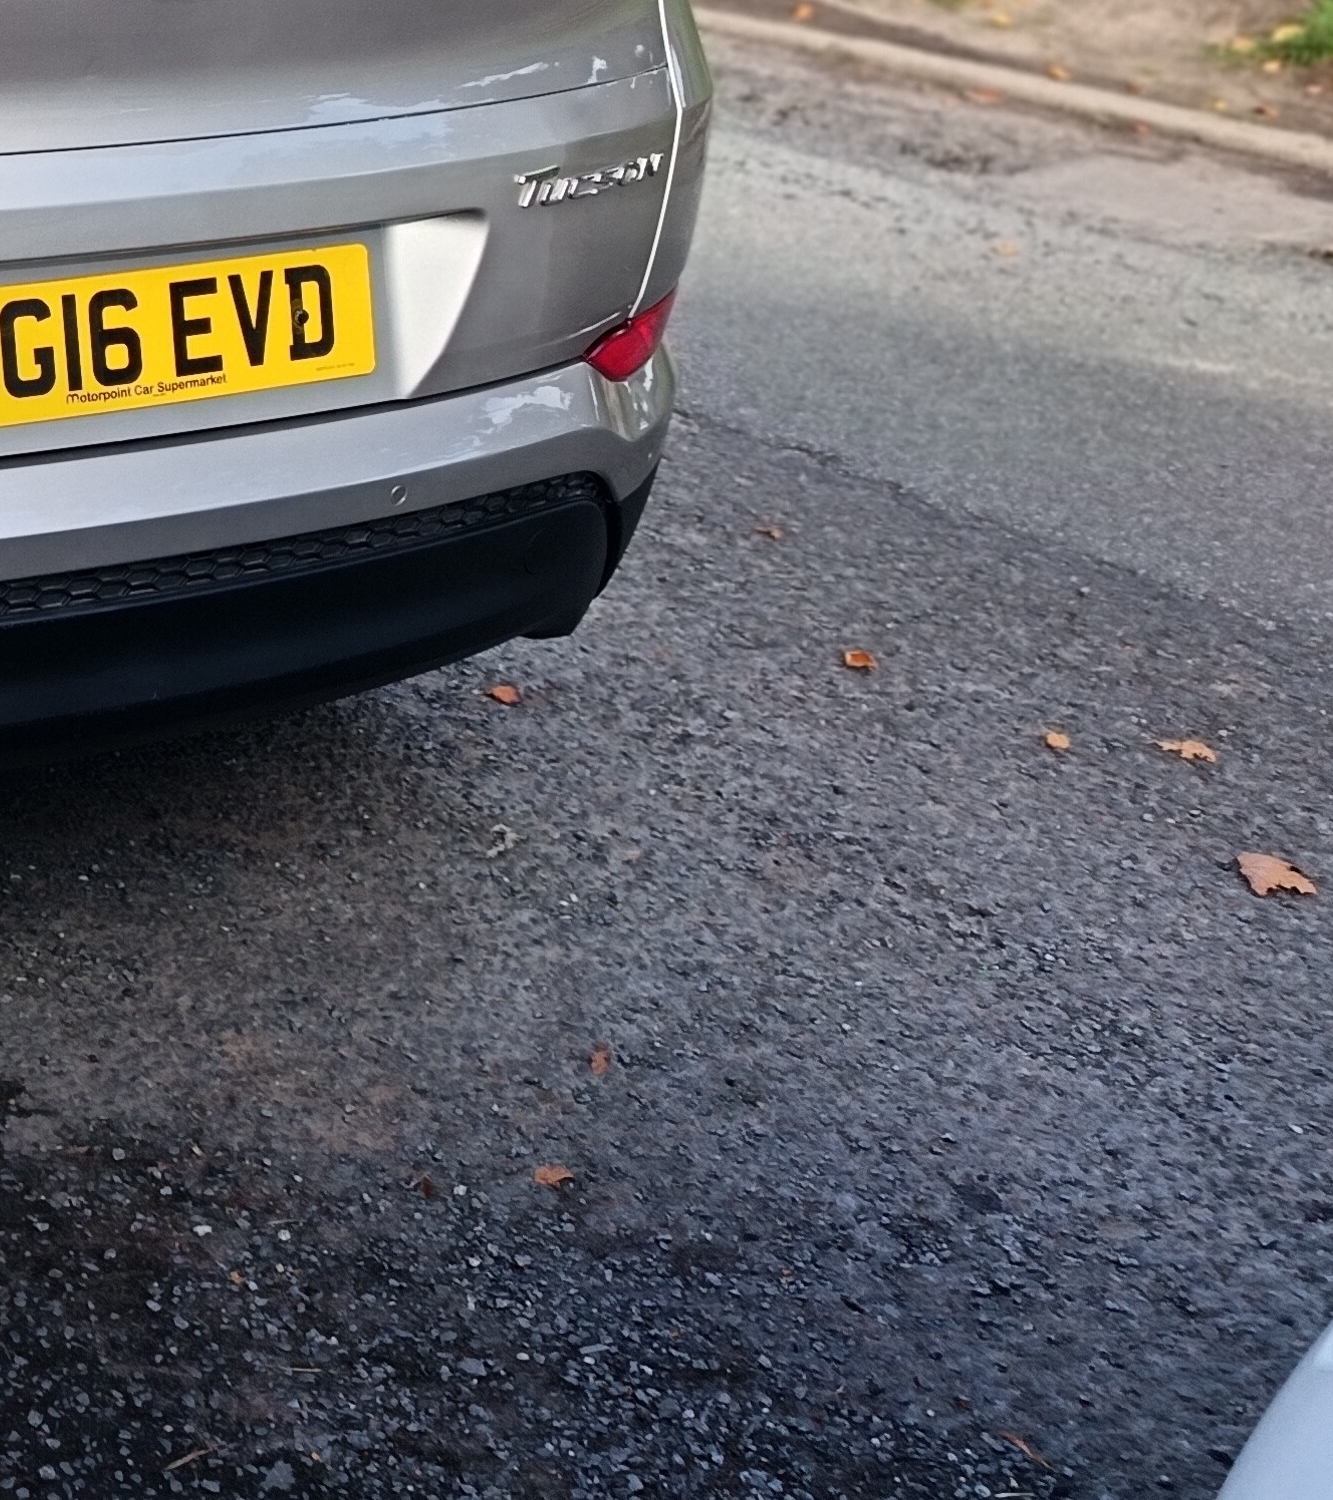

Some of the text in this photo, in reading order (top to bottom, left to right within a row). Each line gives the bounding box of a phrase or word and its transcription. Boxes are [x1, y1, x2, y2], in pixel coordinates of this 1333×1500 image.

[169, 264, 334, 377] EVD
[66, 373, 227, 405] Motorpoint Car Supermarket
